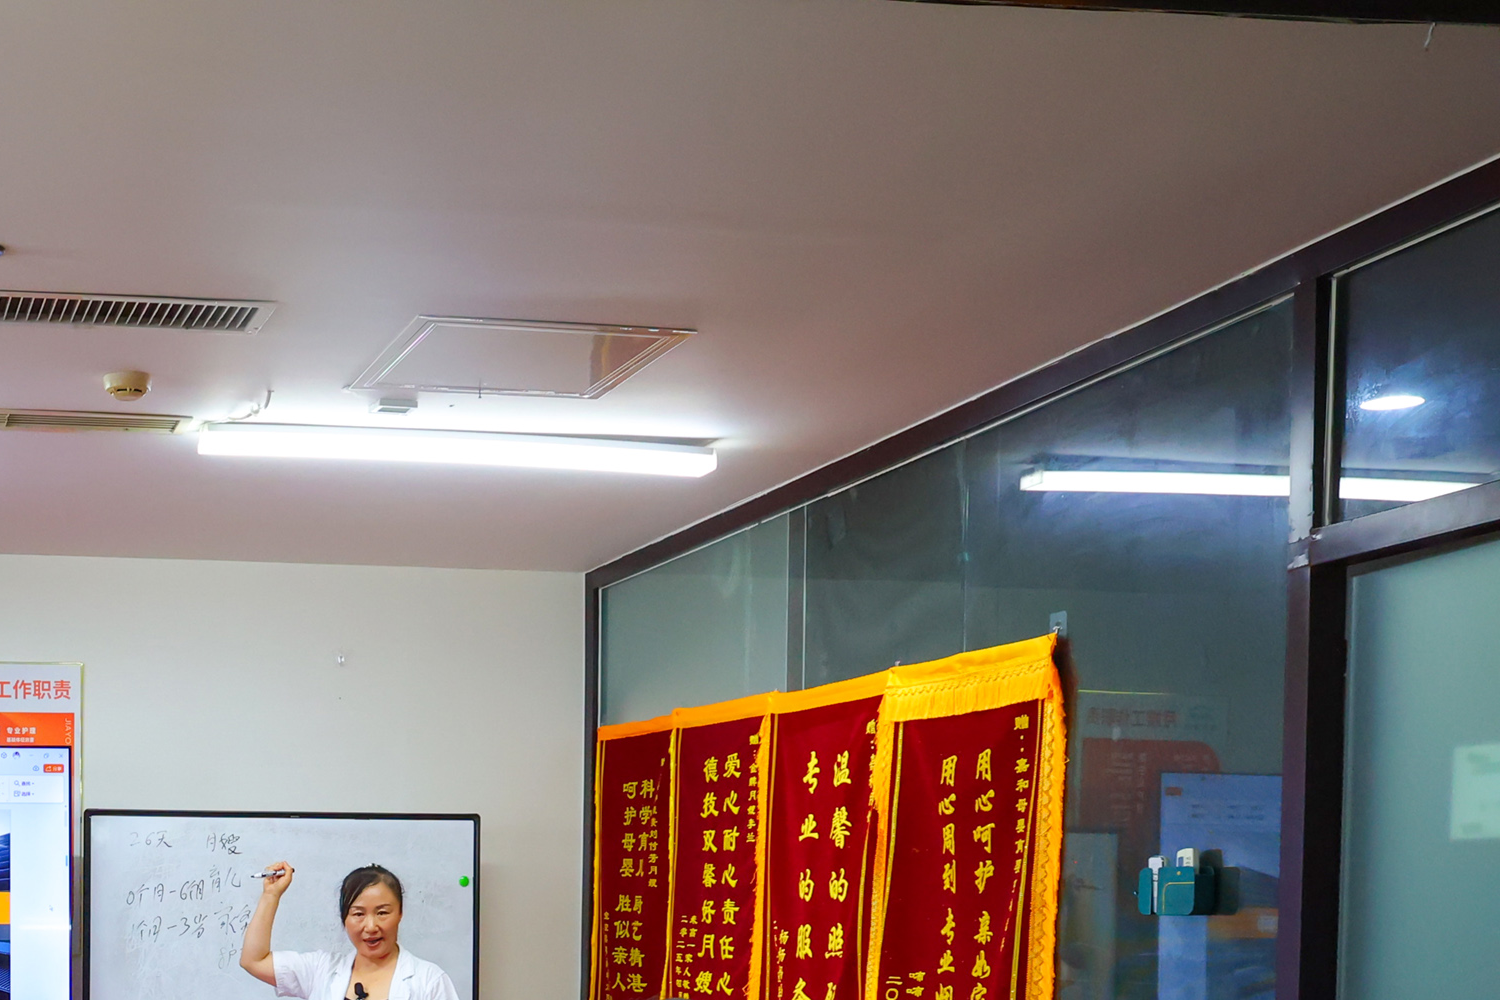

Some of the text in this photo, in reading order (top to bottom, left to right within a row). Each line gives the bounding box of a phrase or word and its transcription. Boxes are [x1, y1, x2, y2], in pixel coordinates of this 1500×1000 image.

[693, 756, 719, 995] 德技双馨好月嫂
[716, 752, 741, 996] 爱心耐心责任心
